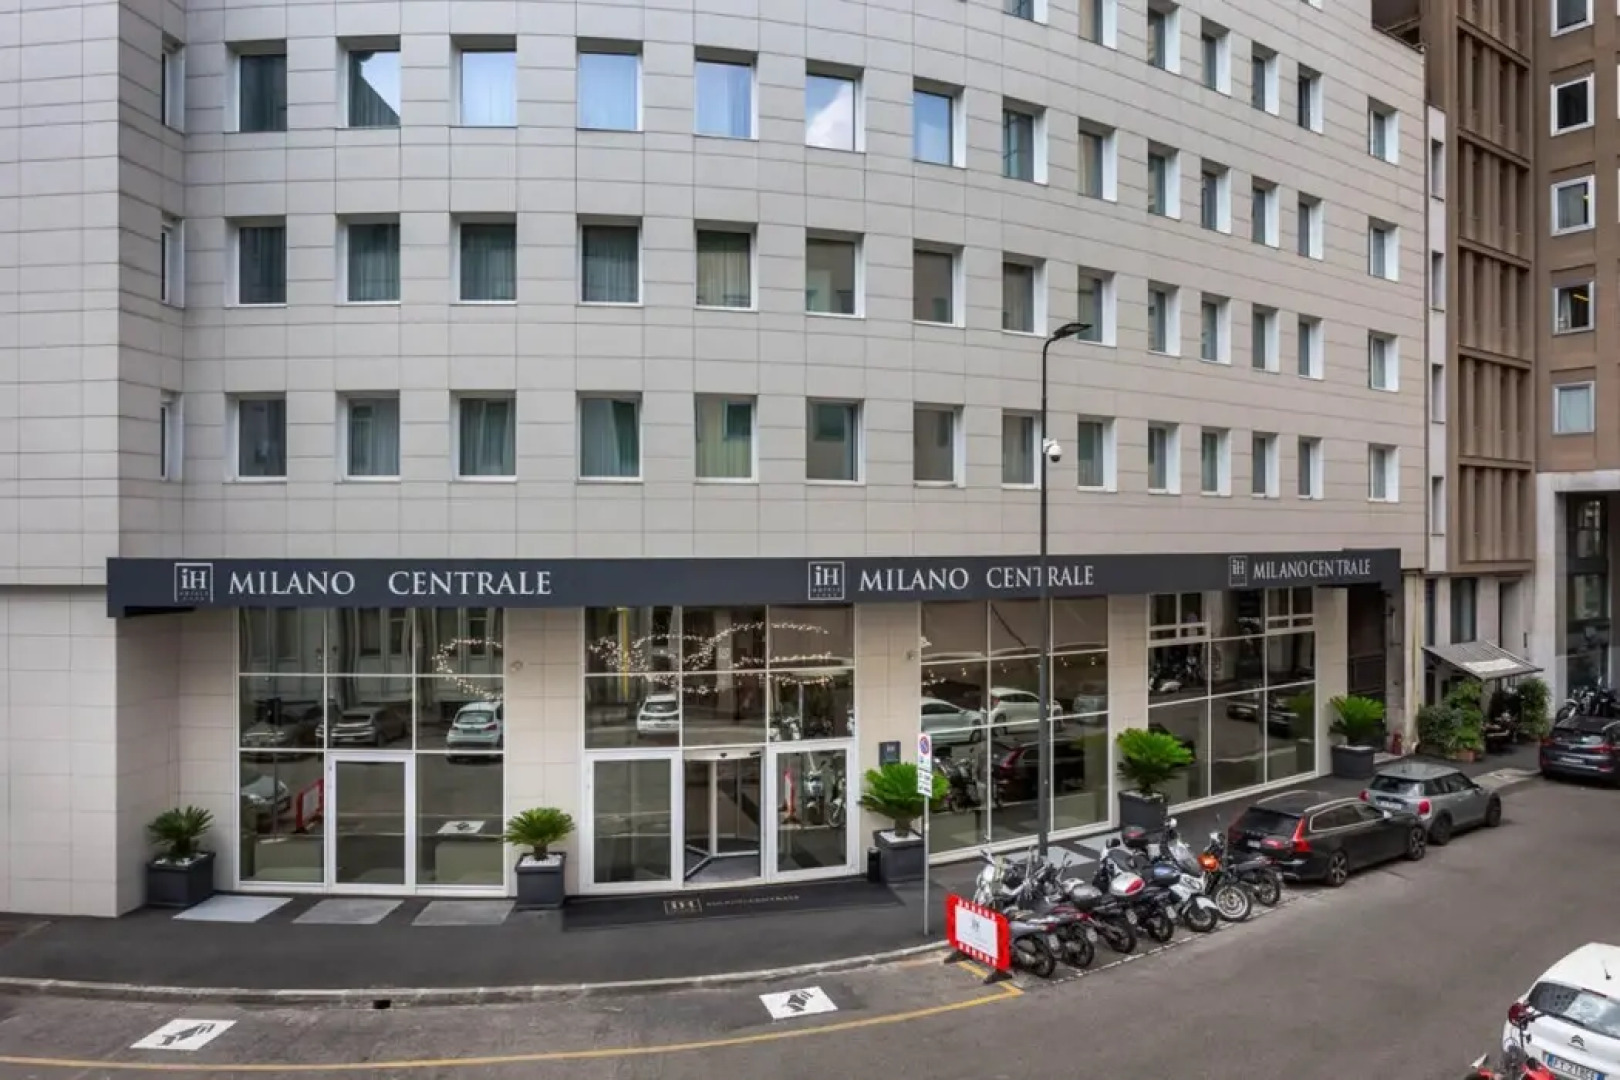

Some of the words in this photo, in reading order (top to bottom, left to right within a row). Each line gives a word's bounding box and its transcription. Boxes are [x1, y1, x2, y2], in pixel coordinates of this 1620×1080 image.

[858, 567, 969, 591] MILANO
[986, 565, 1094, 589] CENTRALE
[1252, 560, 1308, 579] MILANO
[228, 570, 355, 595] MILANO
[388, 570, 552, 595] CENTRALE
